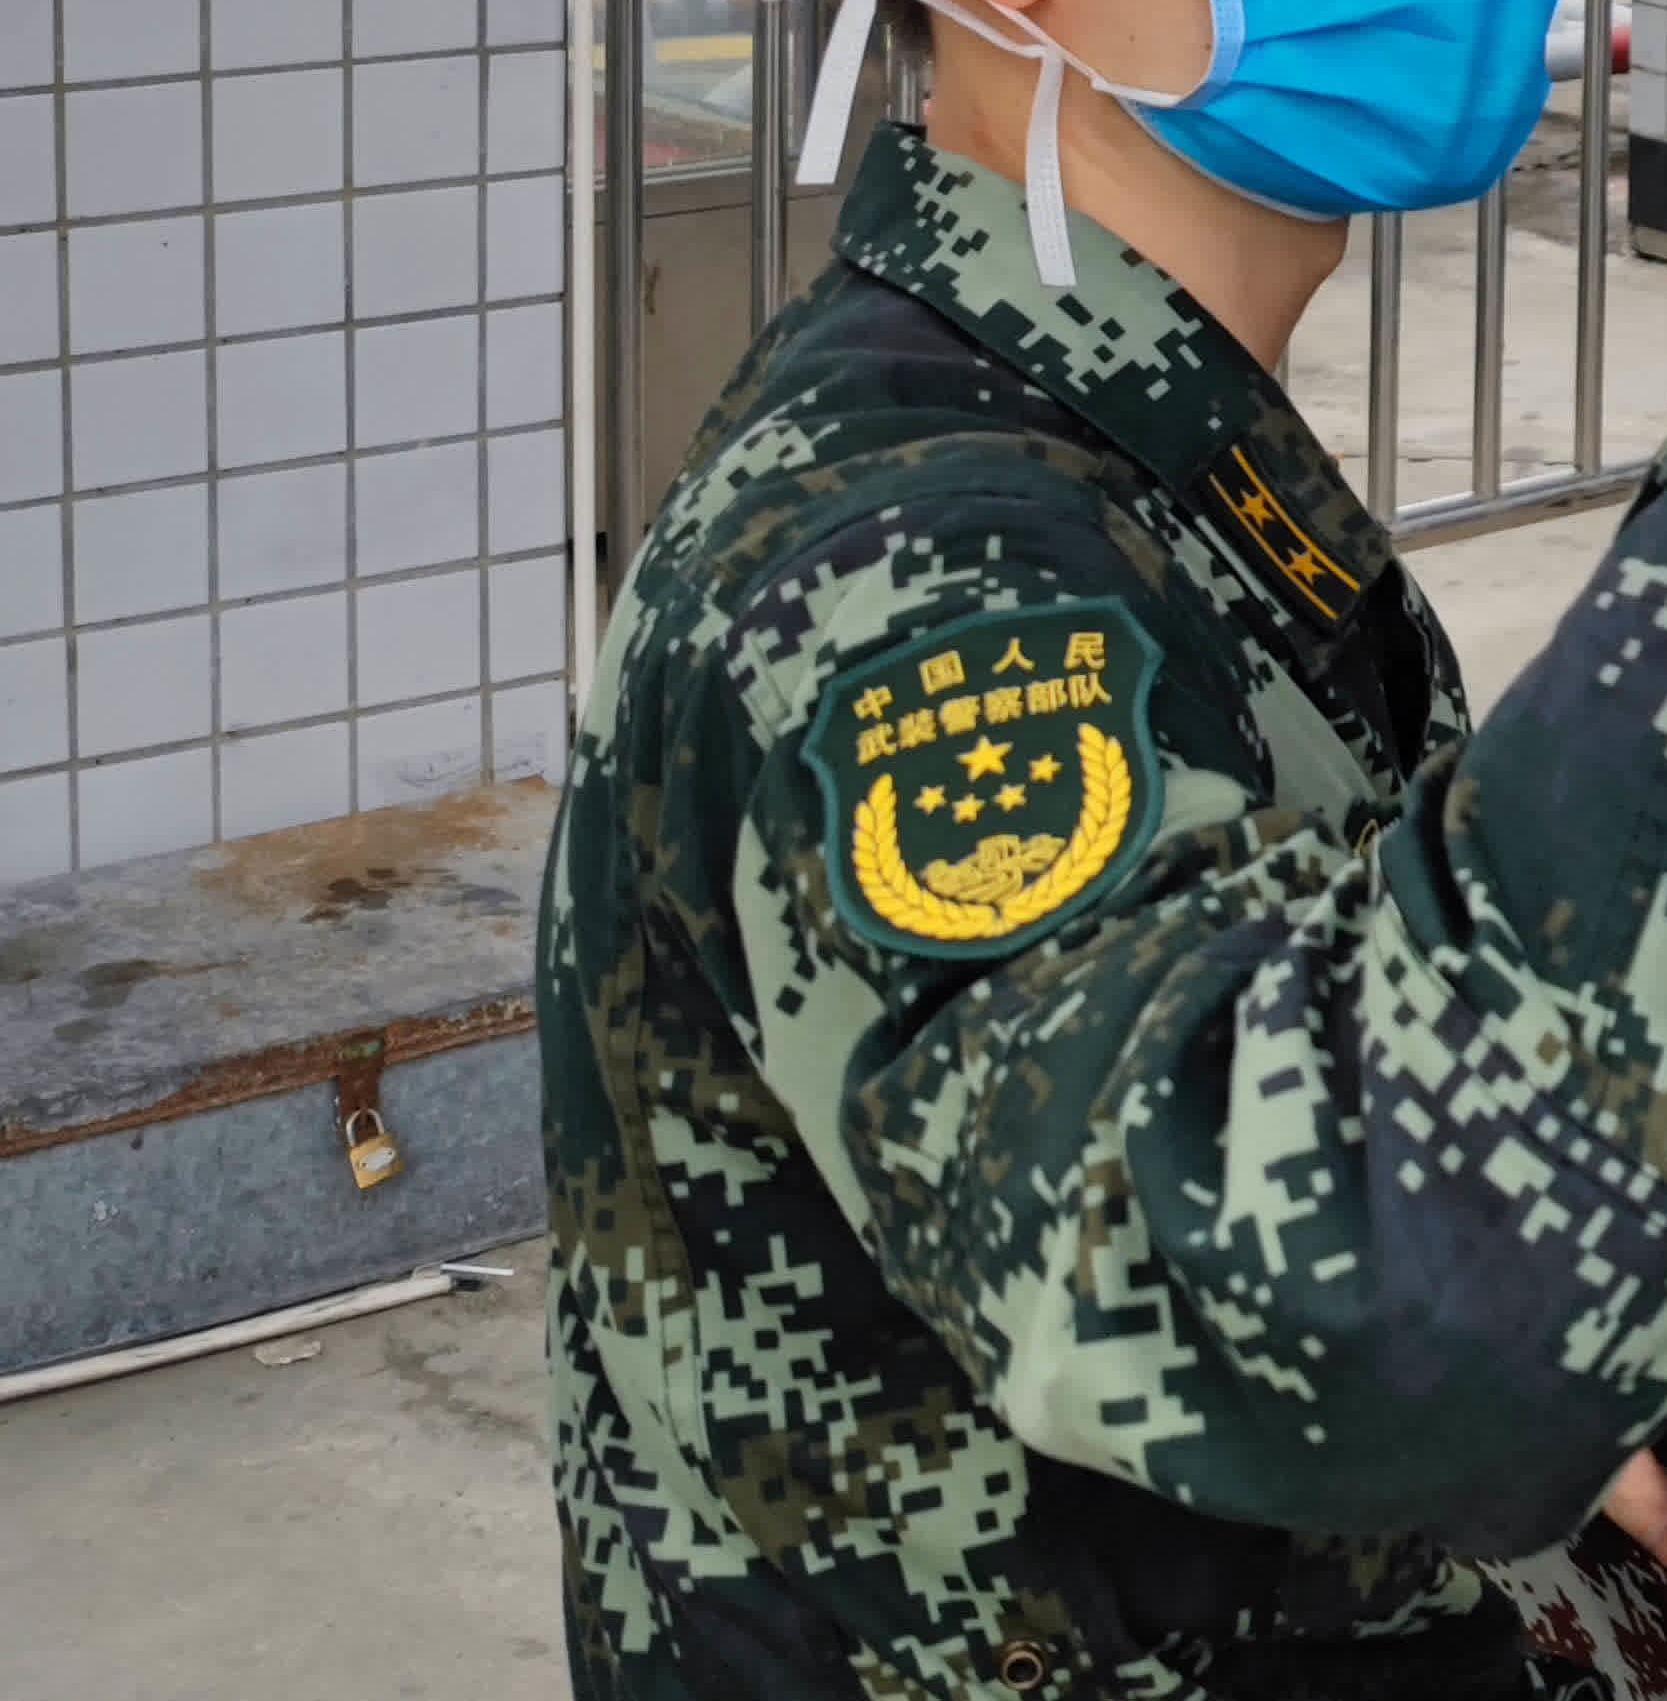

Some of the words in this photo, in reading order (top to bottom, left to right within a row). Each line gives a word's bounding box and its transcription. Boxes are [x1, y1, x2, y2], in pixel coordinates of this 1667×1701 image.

[853, 632, 1106, 720] 中国人民
[856, 672, 1112, 766] 武装警察部队
